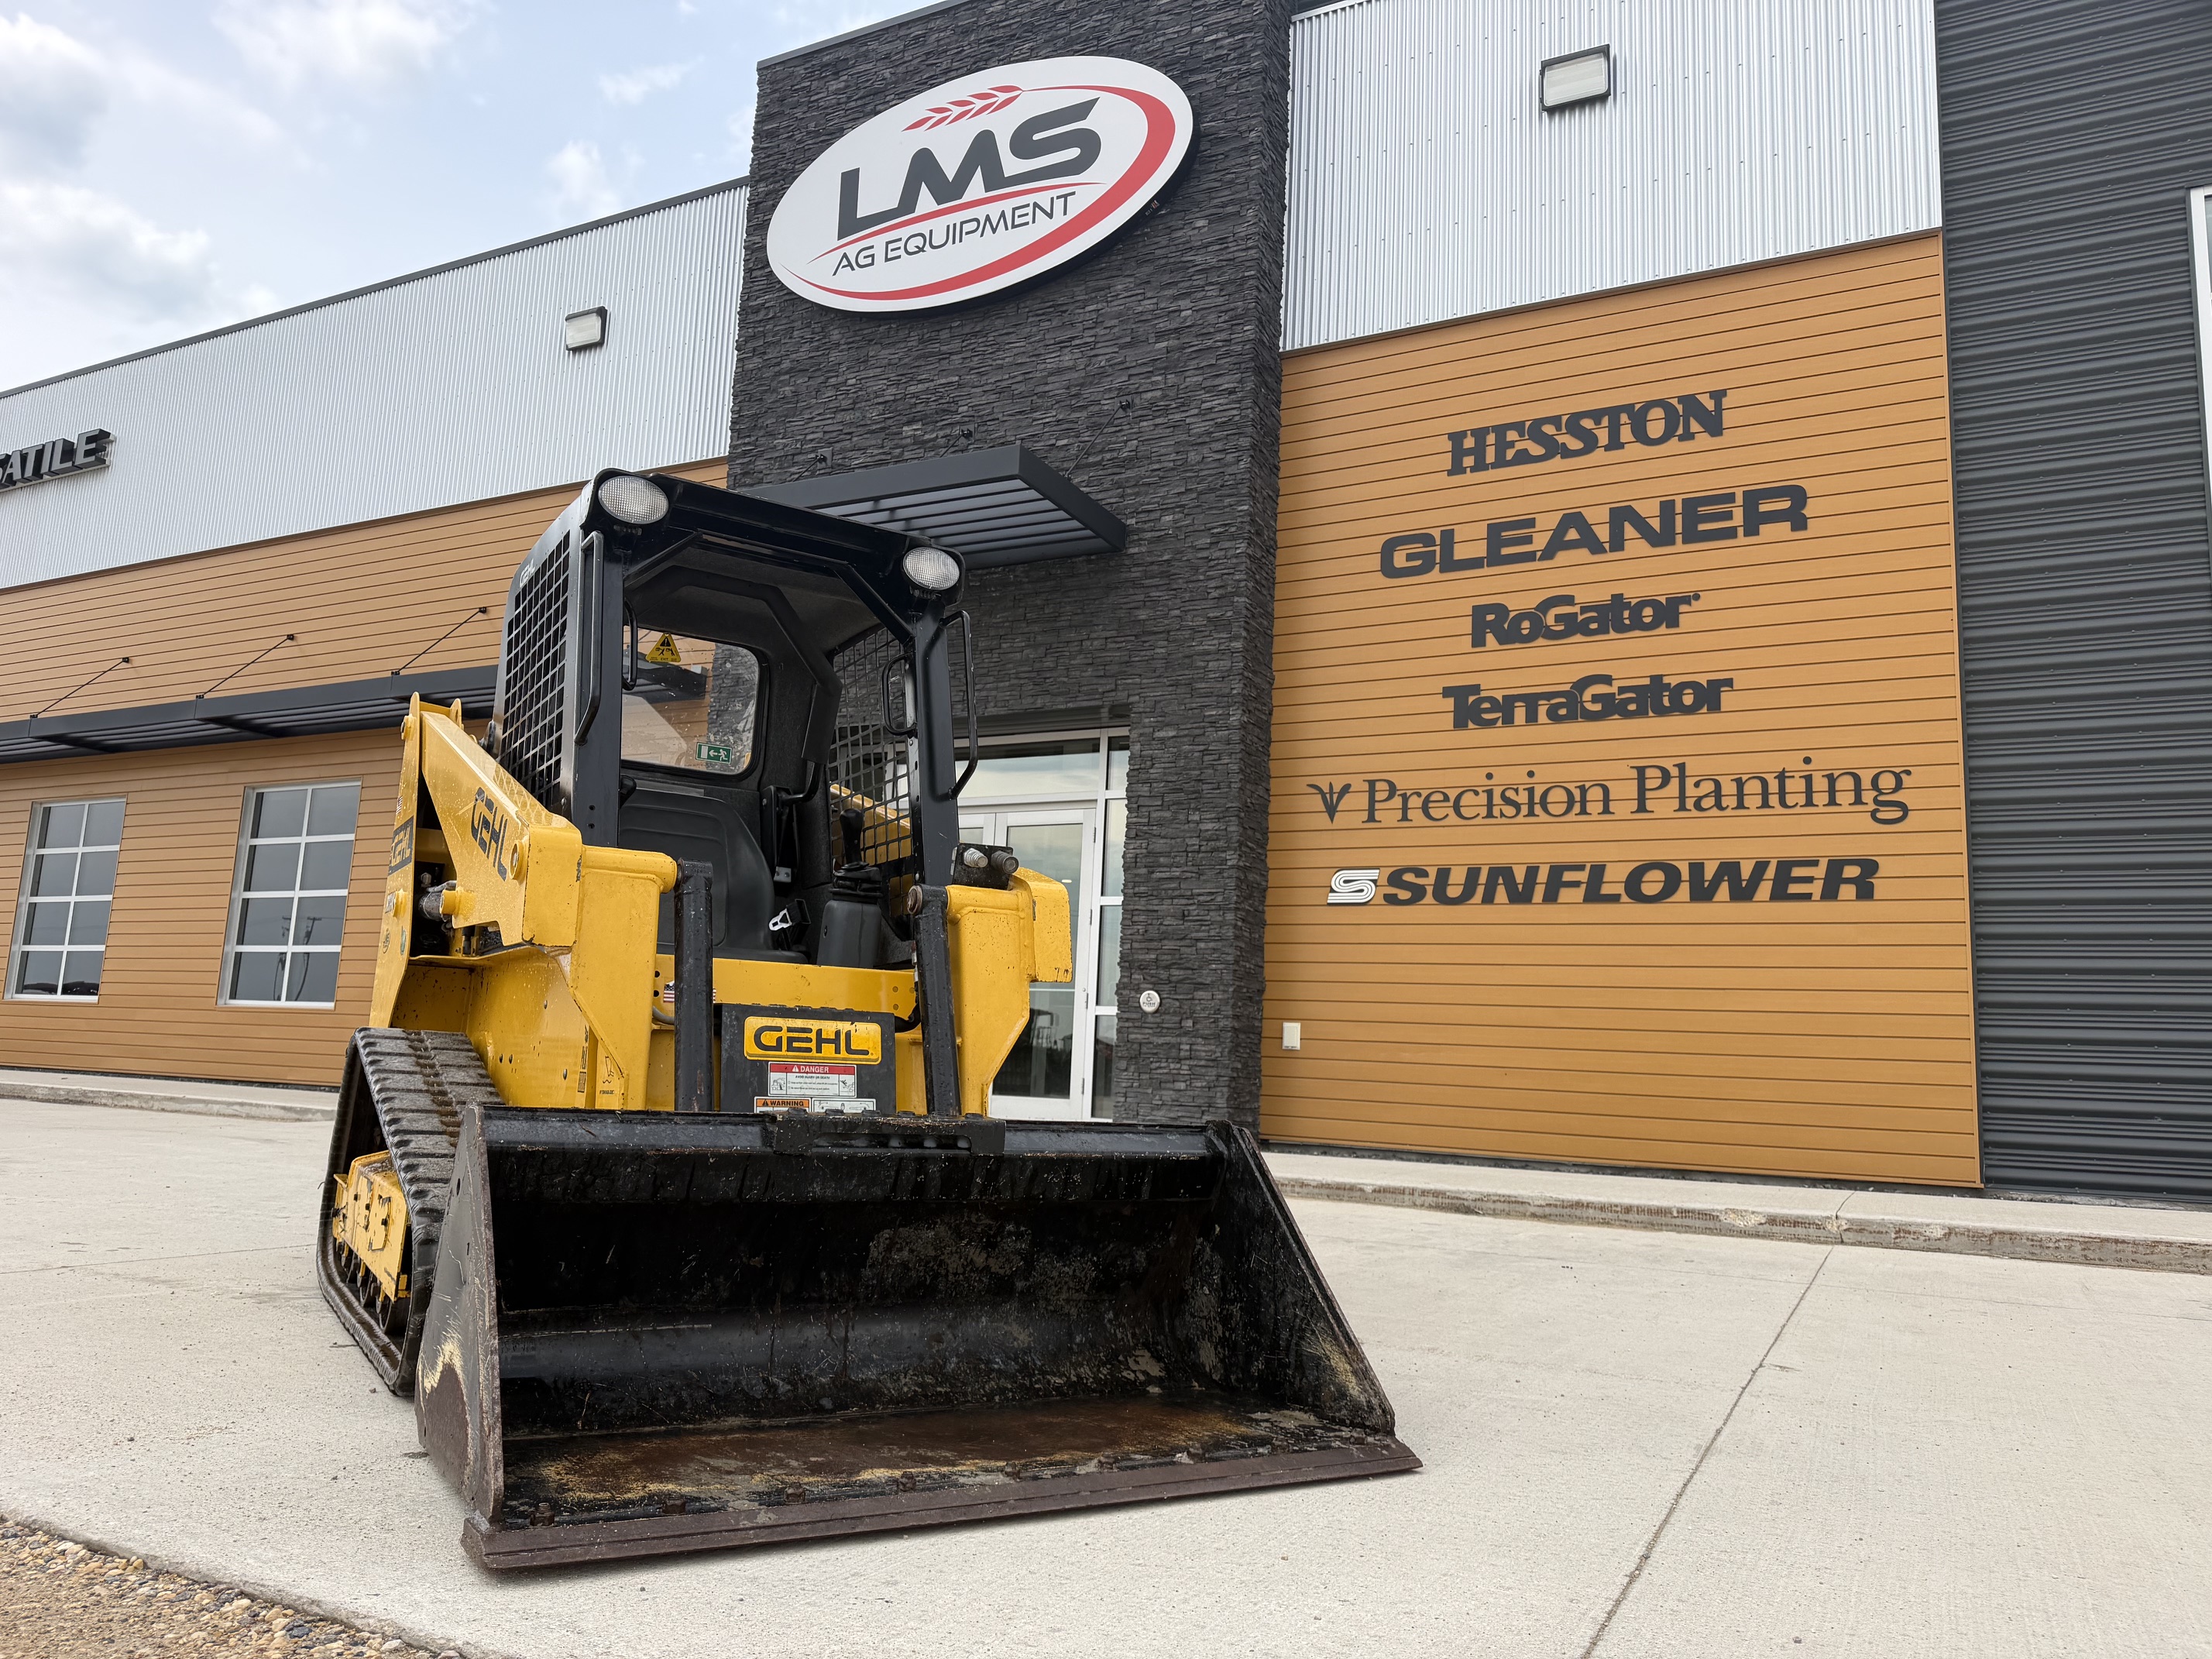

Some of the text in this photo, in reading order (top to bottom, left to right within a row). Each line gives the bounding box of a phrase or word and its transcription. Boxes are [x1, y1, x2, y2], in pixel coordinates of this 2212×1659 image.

[837, 96, 1101, 242] LMS
[832, 191, 1076, 276] AG EQUIPMENT
[1447, 389, 1728, 477] HESSTON
[1380, 484, 1808, 579] GLEANER
[1471, 592, 1692, 648] RoGator
[1441, 673, 1734, 730] TerraGator
[1361, 755, 1912, 826] Precision Planting
[471, 786, 508, 882] GEHL
[1382, 858, 1881, 906] SUNFLOWER
[800, 1065, 830, 1073] DANGER
